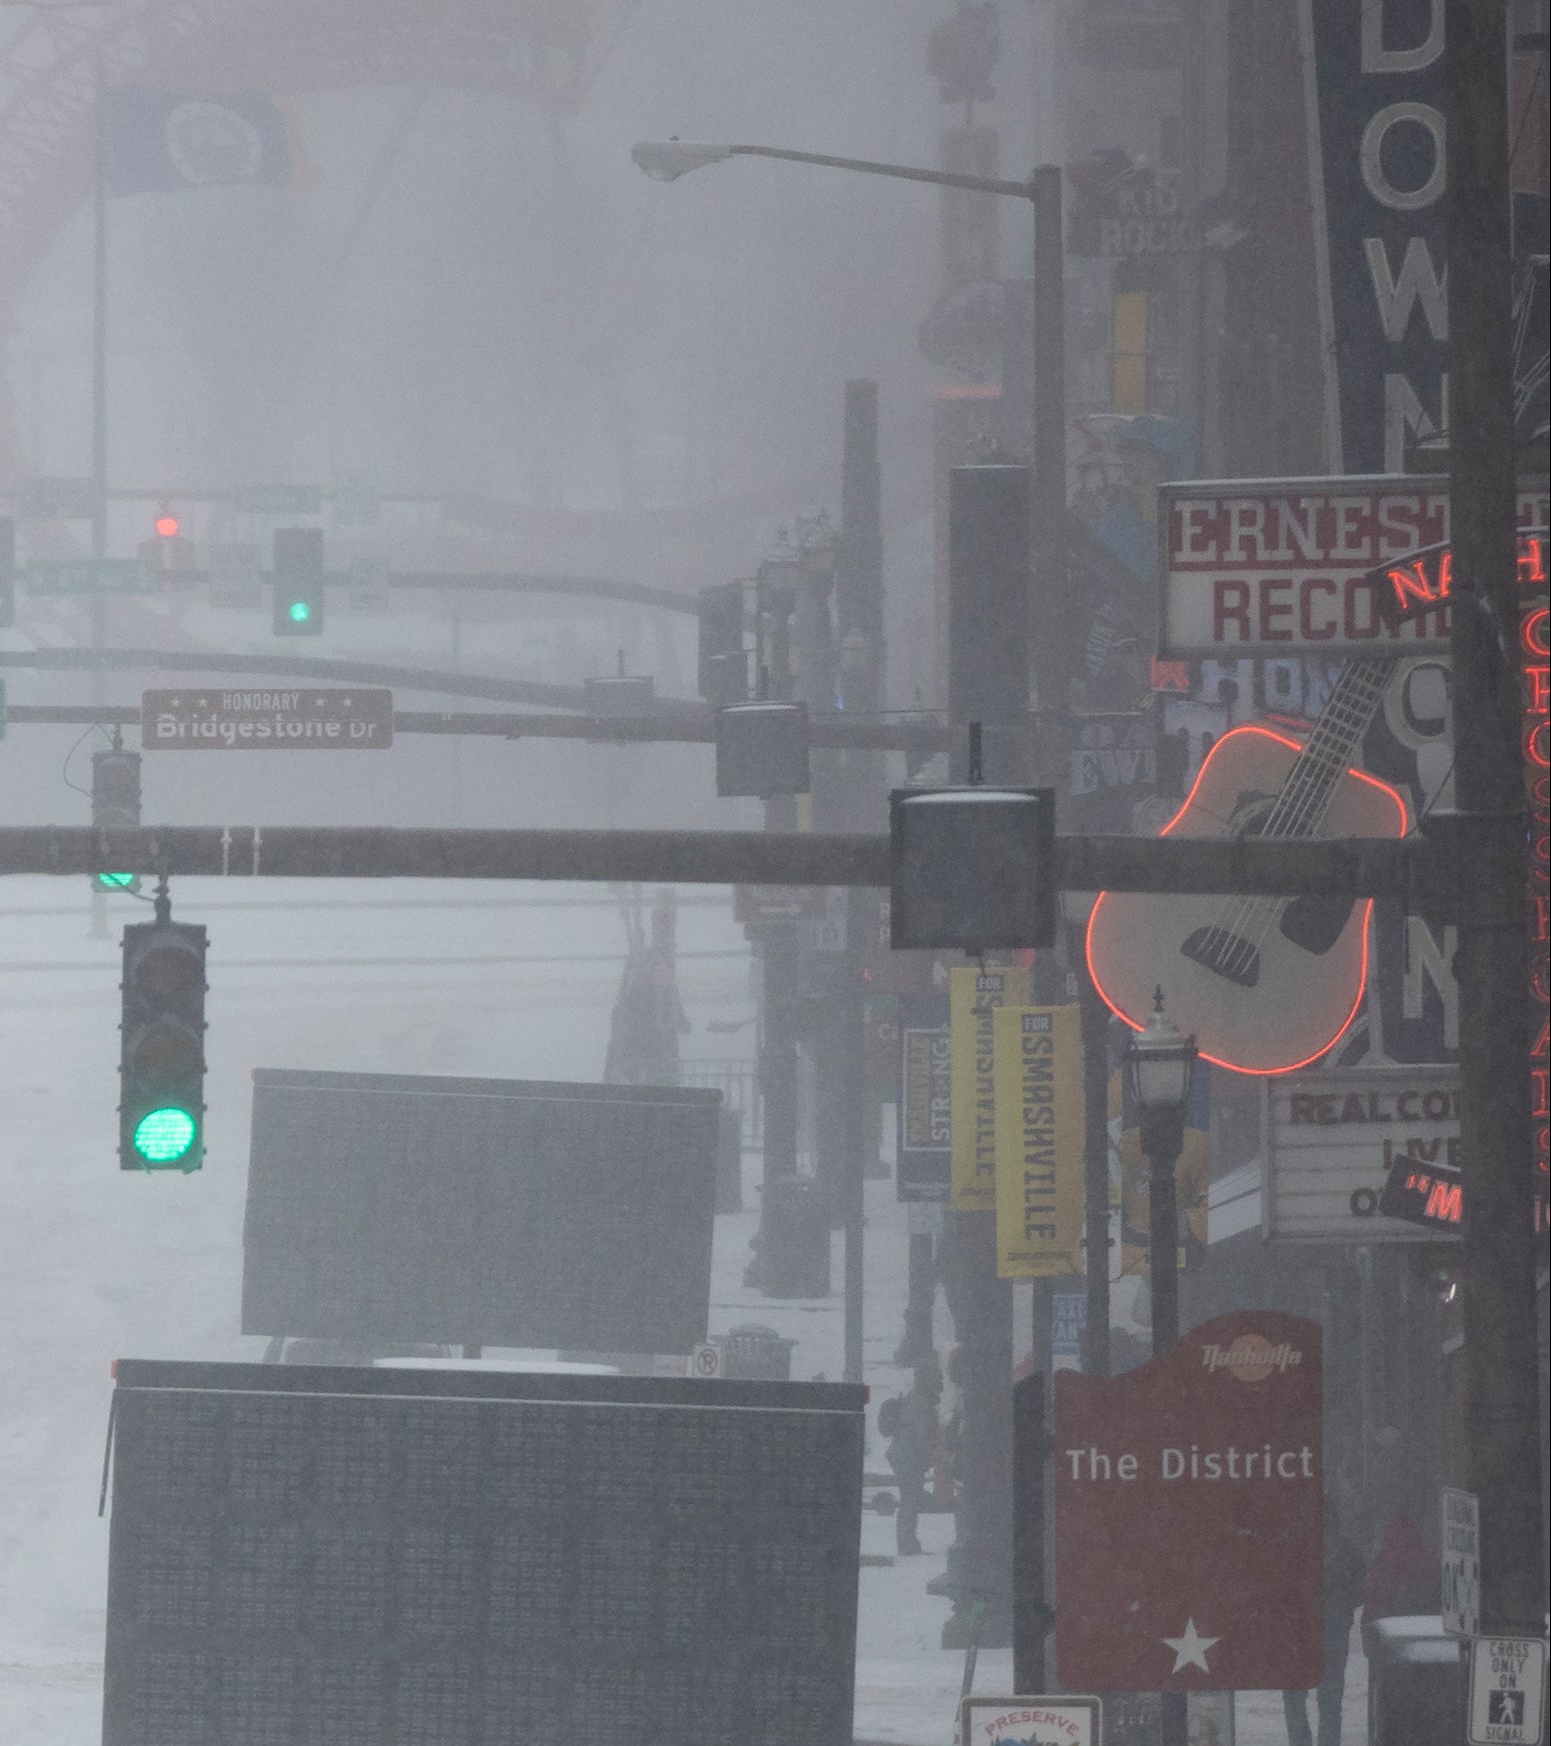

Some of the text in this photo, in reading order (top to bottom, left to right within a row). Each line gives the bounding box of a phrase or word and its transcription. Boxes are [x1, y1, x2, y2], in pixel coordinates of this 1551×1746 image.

[222, 691, 299, 711] HONORARY
[156, 711, 378, 747] Bridgestone Dr
[1021, 1016, 1049, 1029] FOR
[1290, 1091, 1391, 1124] REAL
[1022, 1034, 1057, 1241] SMASHVILLE
[1066, 1443, 1315, 1481] The District
[1489, 1642, 1530, 1658] CROSS
[1491, 1658, 1526, 1674] ONLY
[1499, 1674, 1517, 1689] ON
[984, 1710, 1081, 1737] PRESERVE
[1485, 1726, 1525, 1741] SIGNAL
